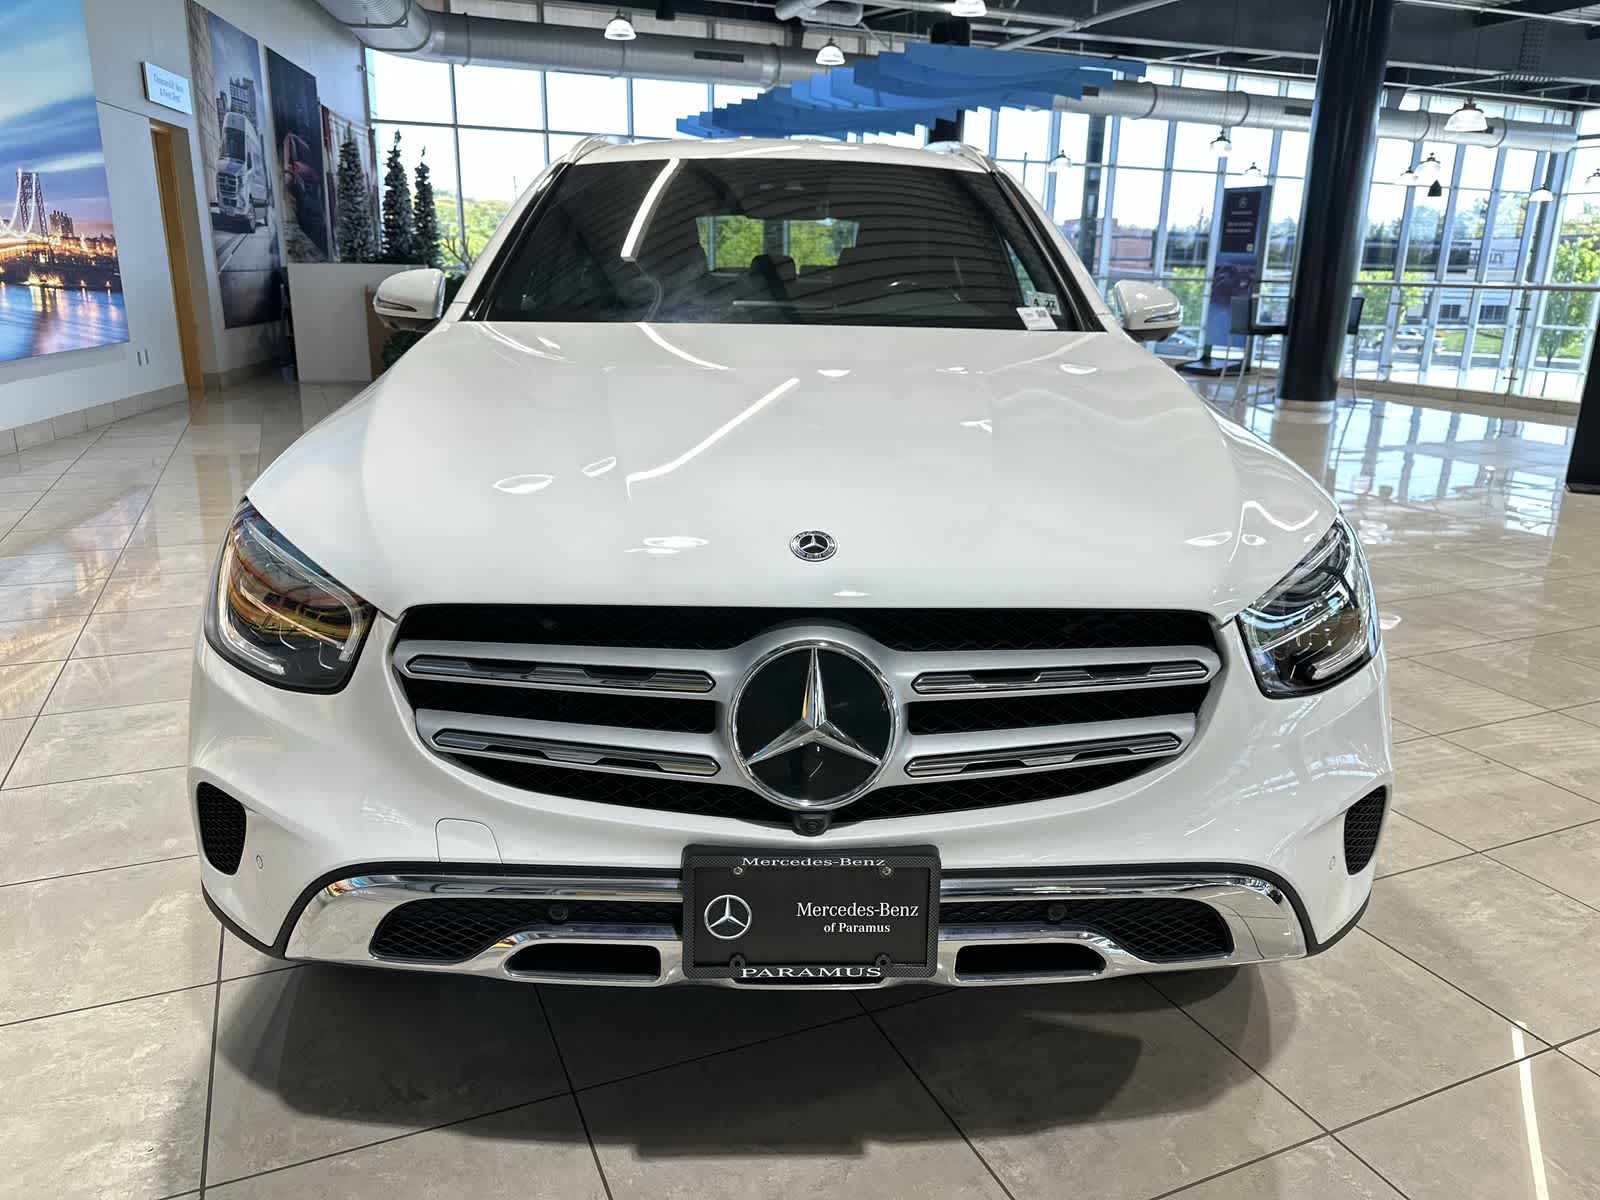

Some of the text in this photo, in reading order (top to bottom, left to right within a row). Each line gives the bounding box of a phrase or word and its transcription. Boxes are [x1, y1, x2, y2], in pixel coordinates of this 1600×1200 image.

[742, 857, 886, 866] Mercedes-Benz
[796, 902, 919, 916] Mercedes-Benz
[823, 922, 891, 933] of Paramus
[741, 967, 881, 977] PARAMUS
